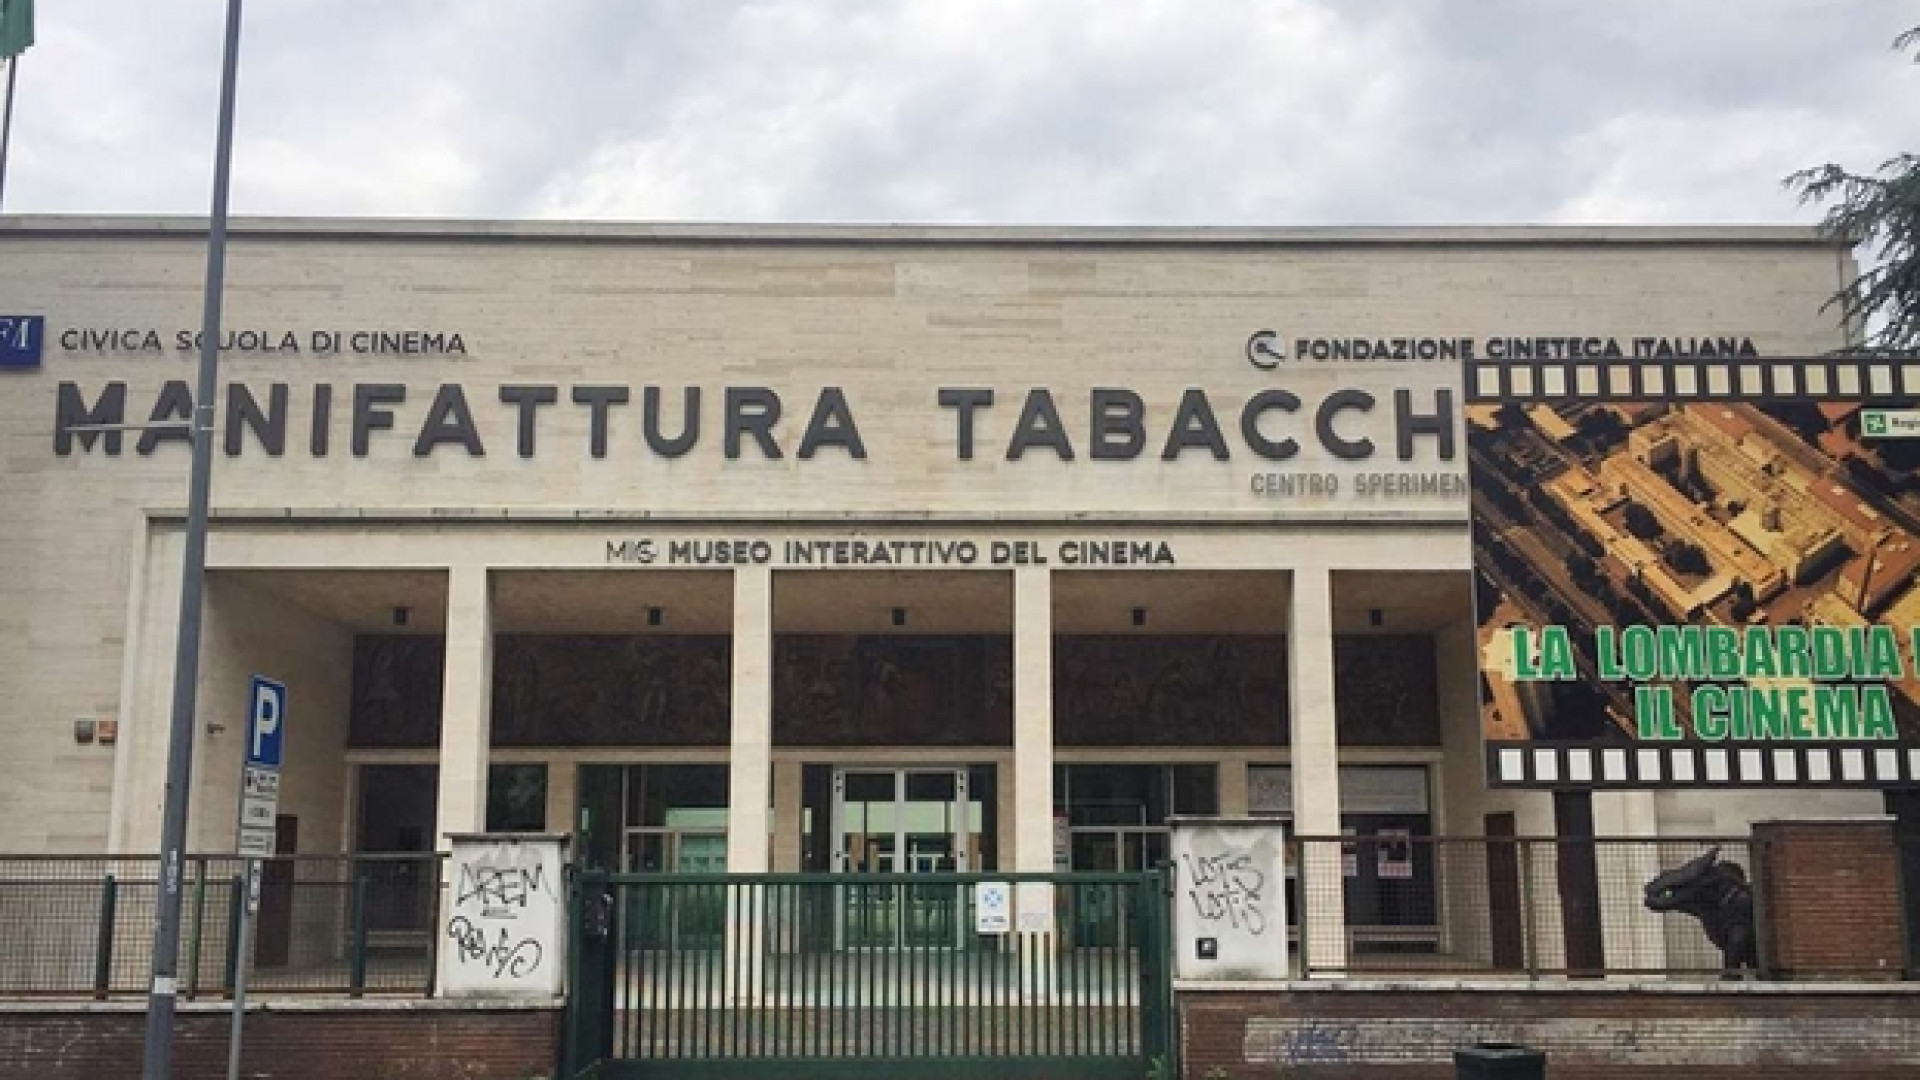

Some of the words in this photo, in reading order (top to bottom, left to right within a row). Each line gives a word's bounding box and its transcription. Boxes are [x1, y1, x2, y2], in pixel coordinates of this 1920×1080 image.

[60, 330, 162, 351] CIVICA
[312, 331, 341, 353] DI
[351, 331, 466, 353] CINEMA
[1295, 337, 1475, 361] FONDAZIONE
[1485, 336, 1623, 357] CINETECA
[1632, 336, 1759, 357] ITALIANA
[54, 380, 867, 459] MANIFATTURA
[937, 387, 1455, 461] TABACCH
[1250, 473, 1338, 496] CENTRO
[668, 540, 771, 564] MUSEO
[785, 540, 979, 564] INTERATTIVO
[990, 540, 1048, 564] DEL
[1058, 540, 1175, 564] CINEMA
[1511, 625, 1577, 681] LA
[1597, 624, 1904, 681] LOMBARDIA
[253, 685, 280, 757] P
[1635, 684, 1682, 741] IL
[1692, 683, 1899, 741] CINEMA
